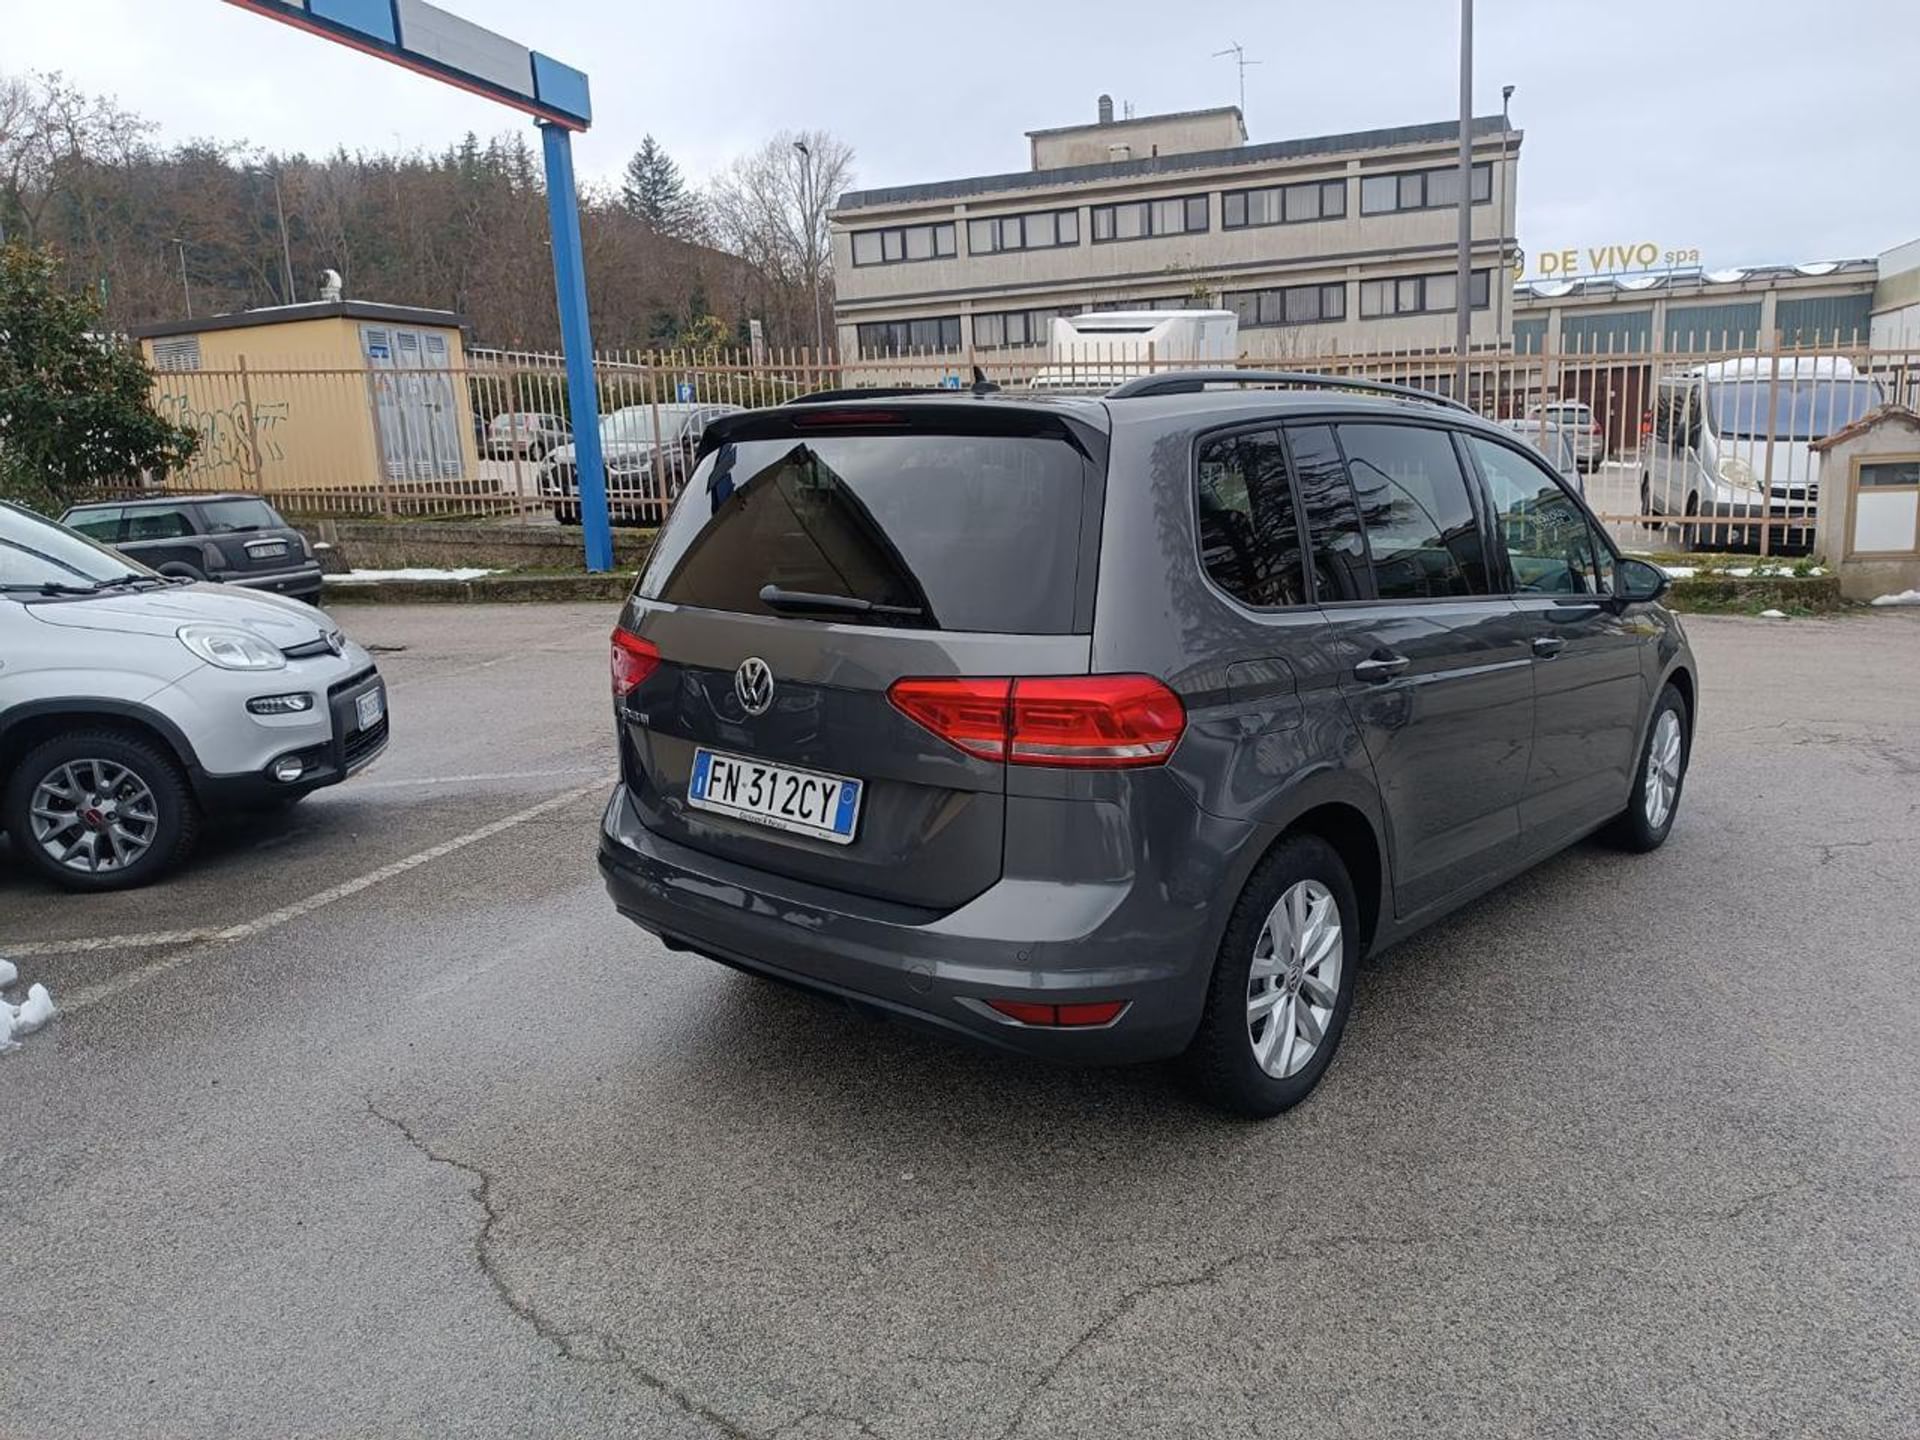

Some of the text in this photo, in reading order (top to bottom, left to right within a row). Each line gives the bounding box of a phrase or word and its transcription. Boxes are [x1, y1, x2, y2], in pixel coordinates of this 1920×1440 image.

[1540, 243, 1700, 274] DE VIVO spa
[707, 760, 836, 823] FN312CY
